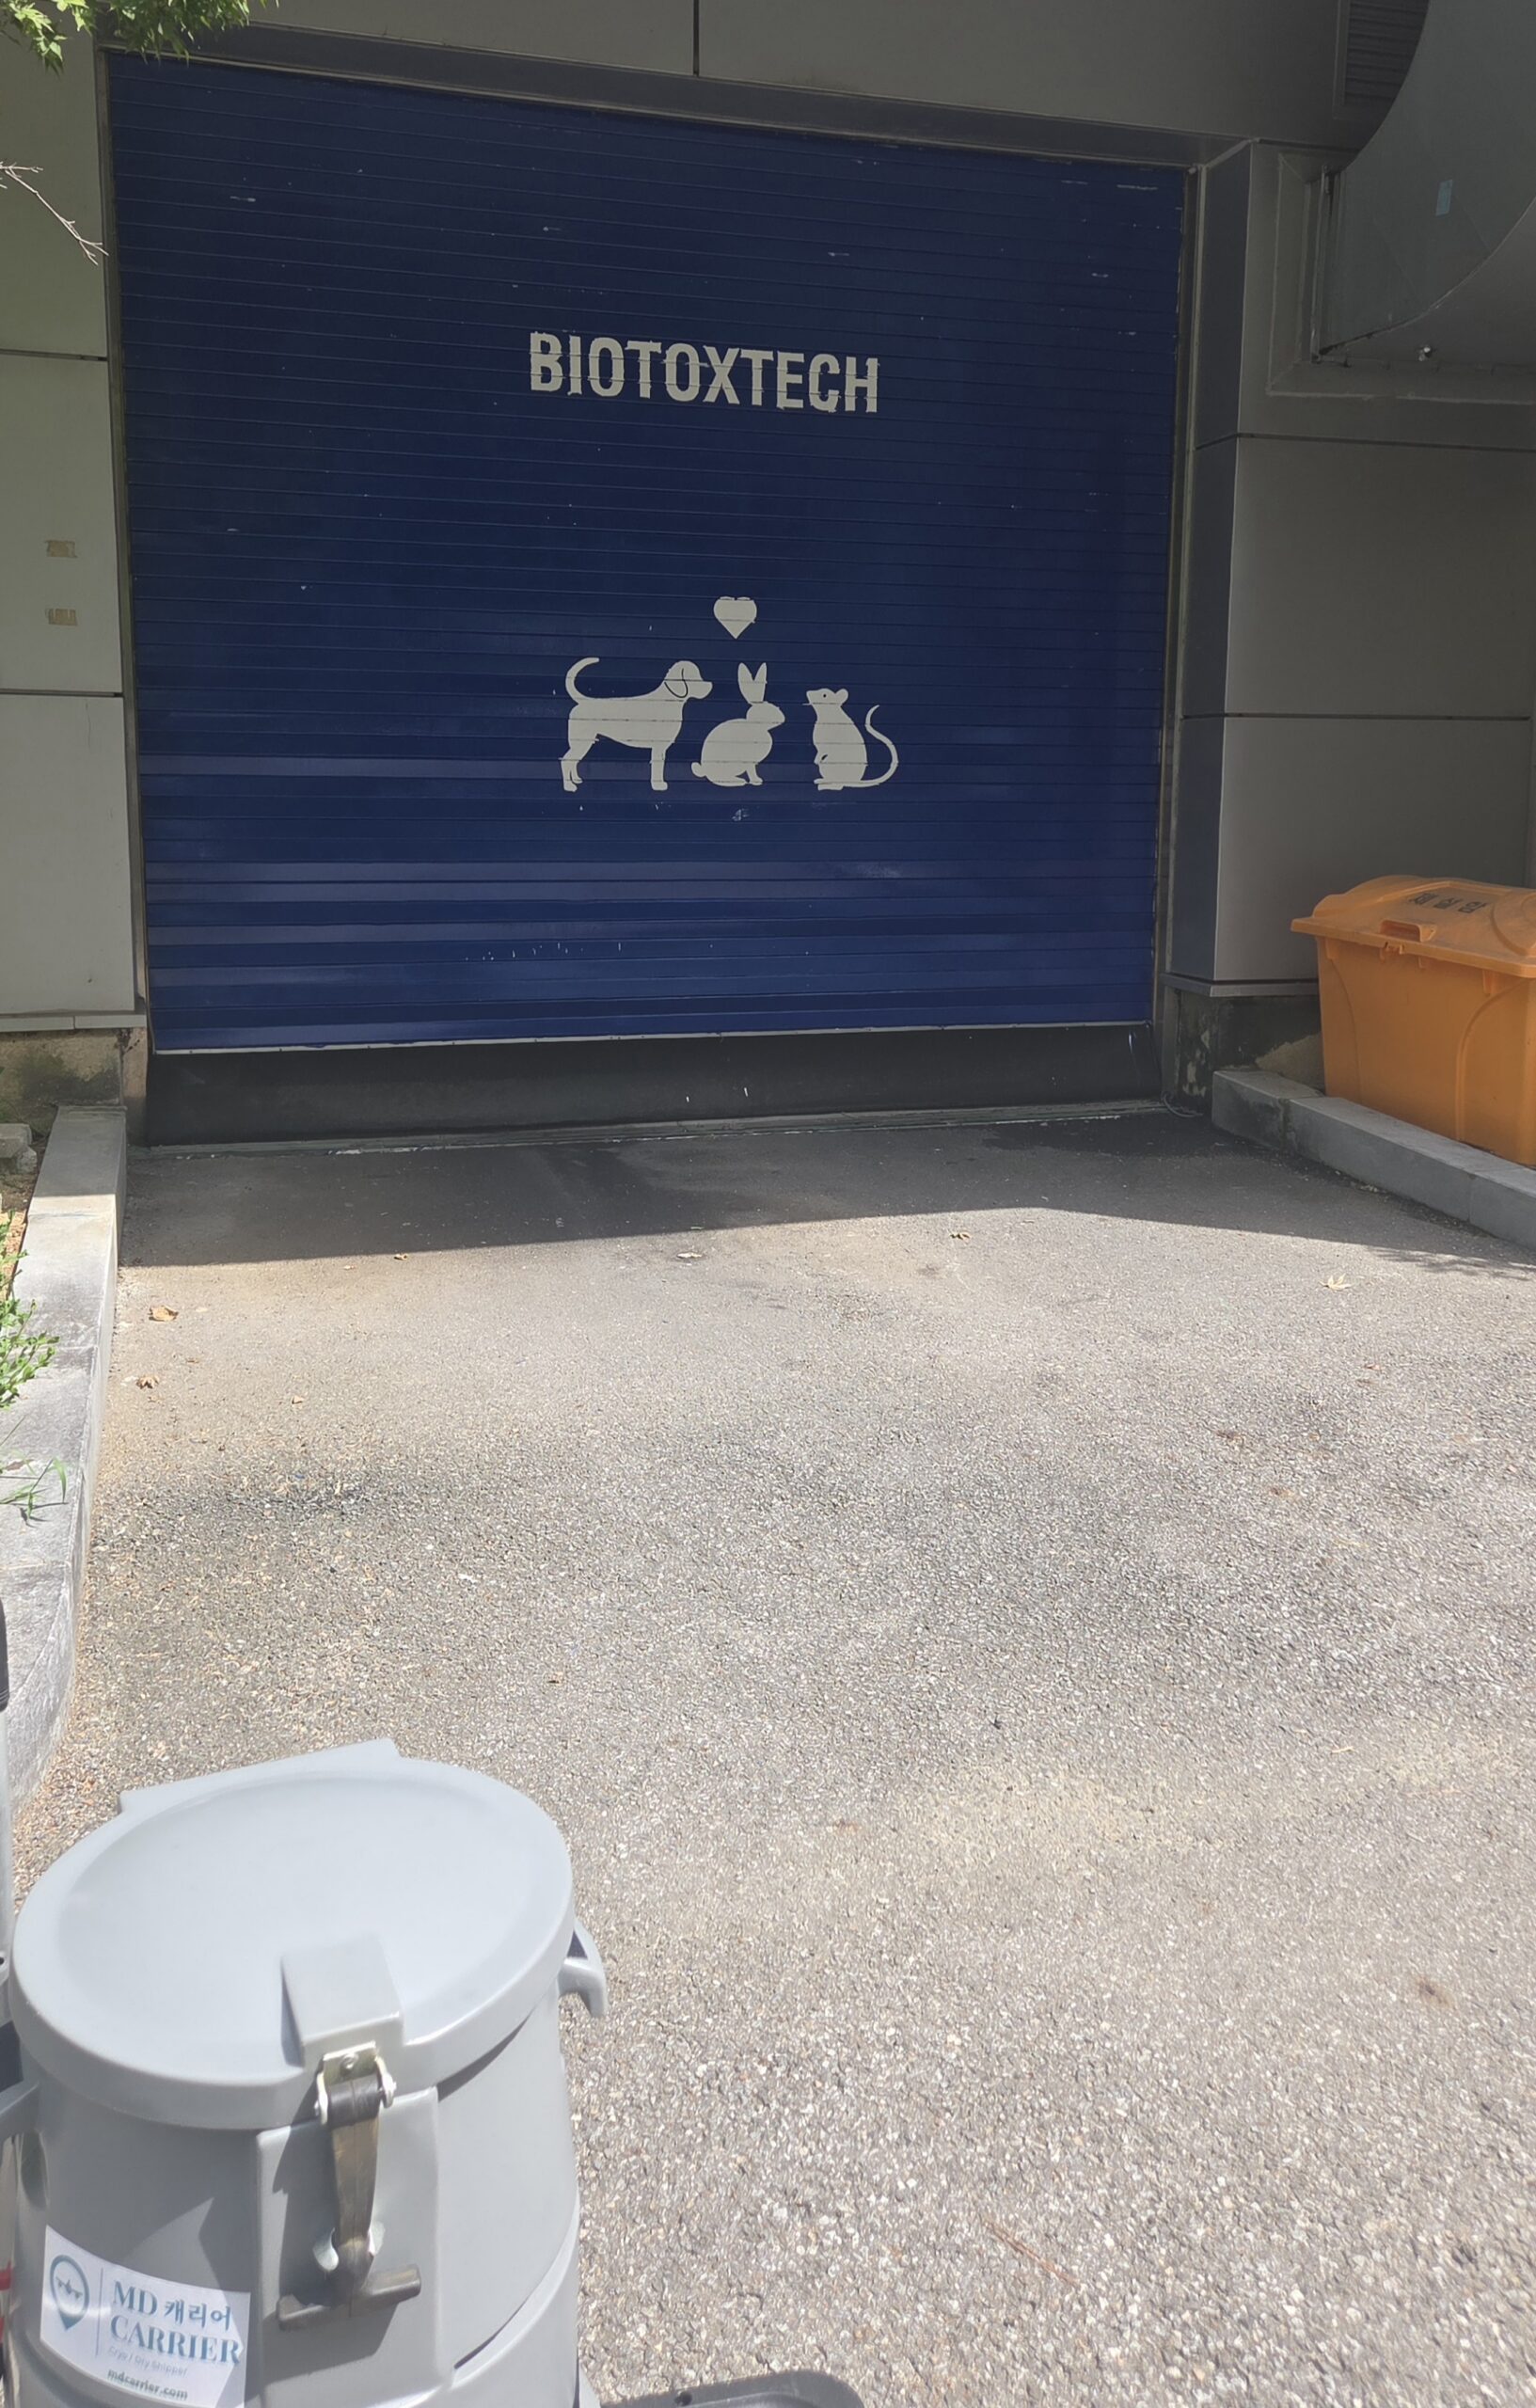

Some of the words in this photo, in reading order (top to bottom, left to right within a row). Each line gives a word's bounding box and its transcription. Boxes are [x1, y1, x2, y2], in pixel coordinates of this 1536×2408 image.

[530, 331, 880, 413] BIOTOXTECH
[113, 2279, 159, 2317] MD
[164, 2298, 232, 2332] 캐리어
[110, 2314, 241, 2365] CARRIER
[106, 2368, 188, 2401] mdcarrier.com
